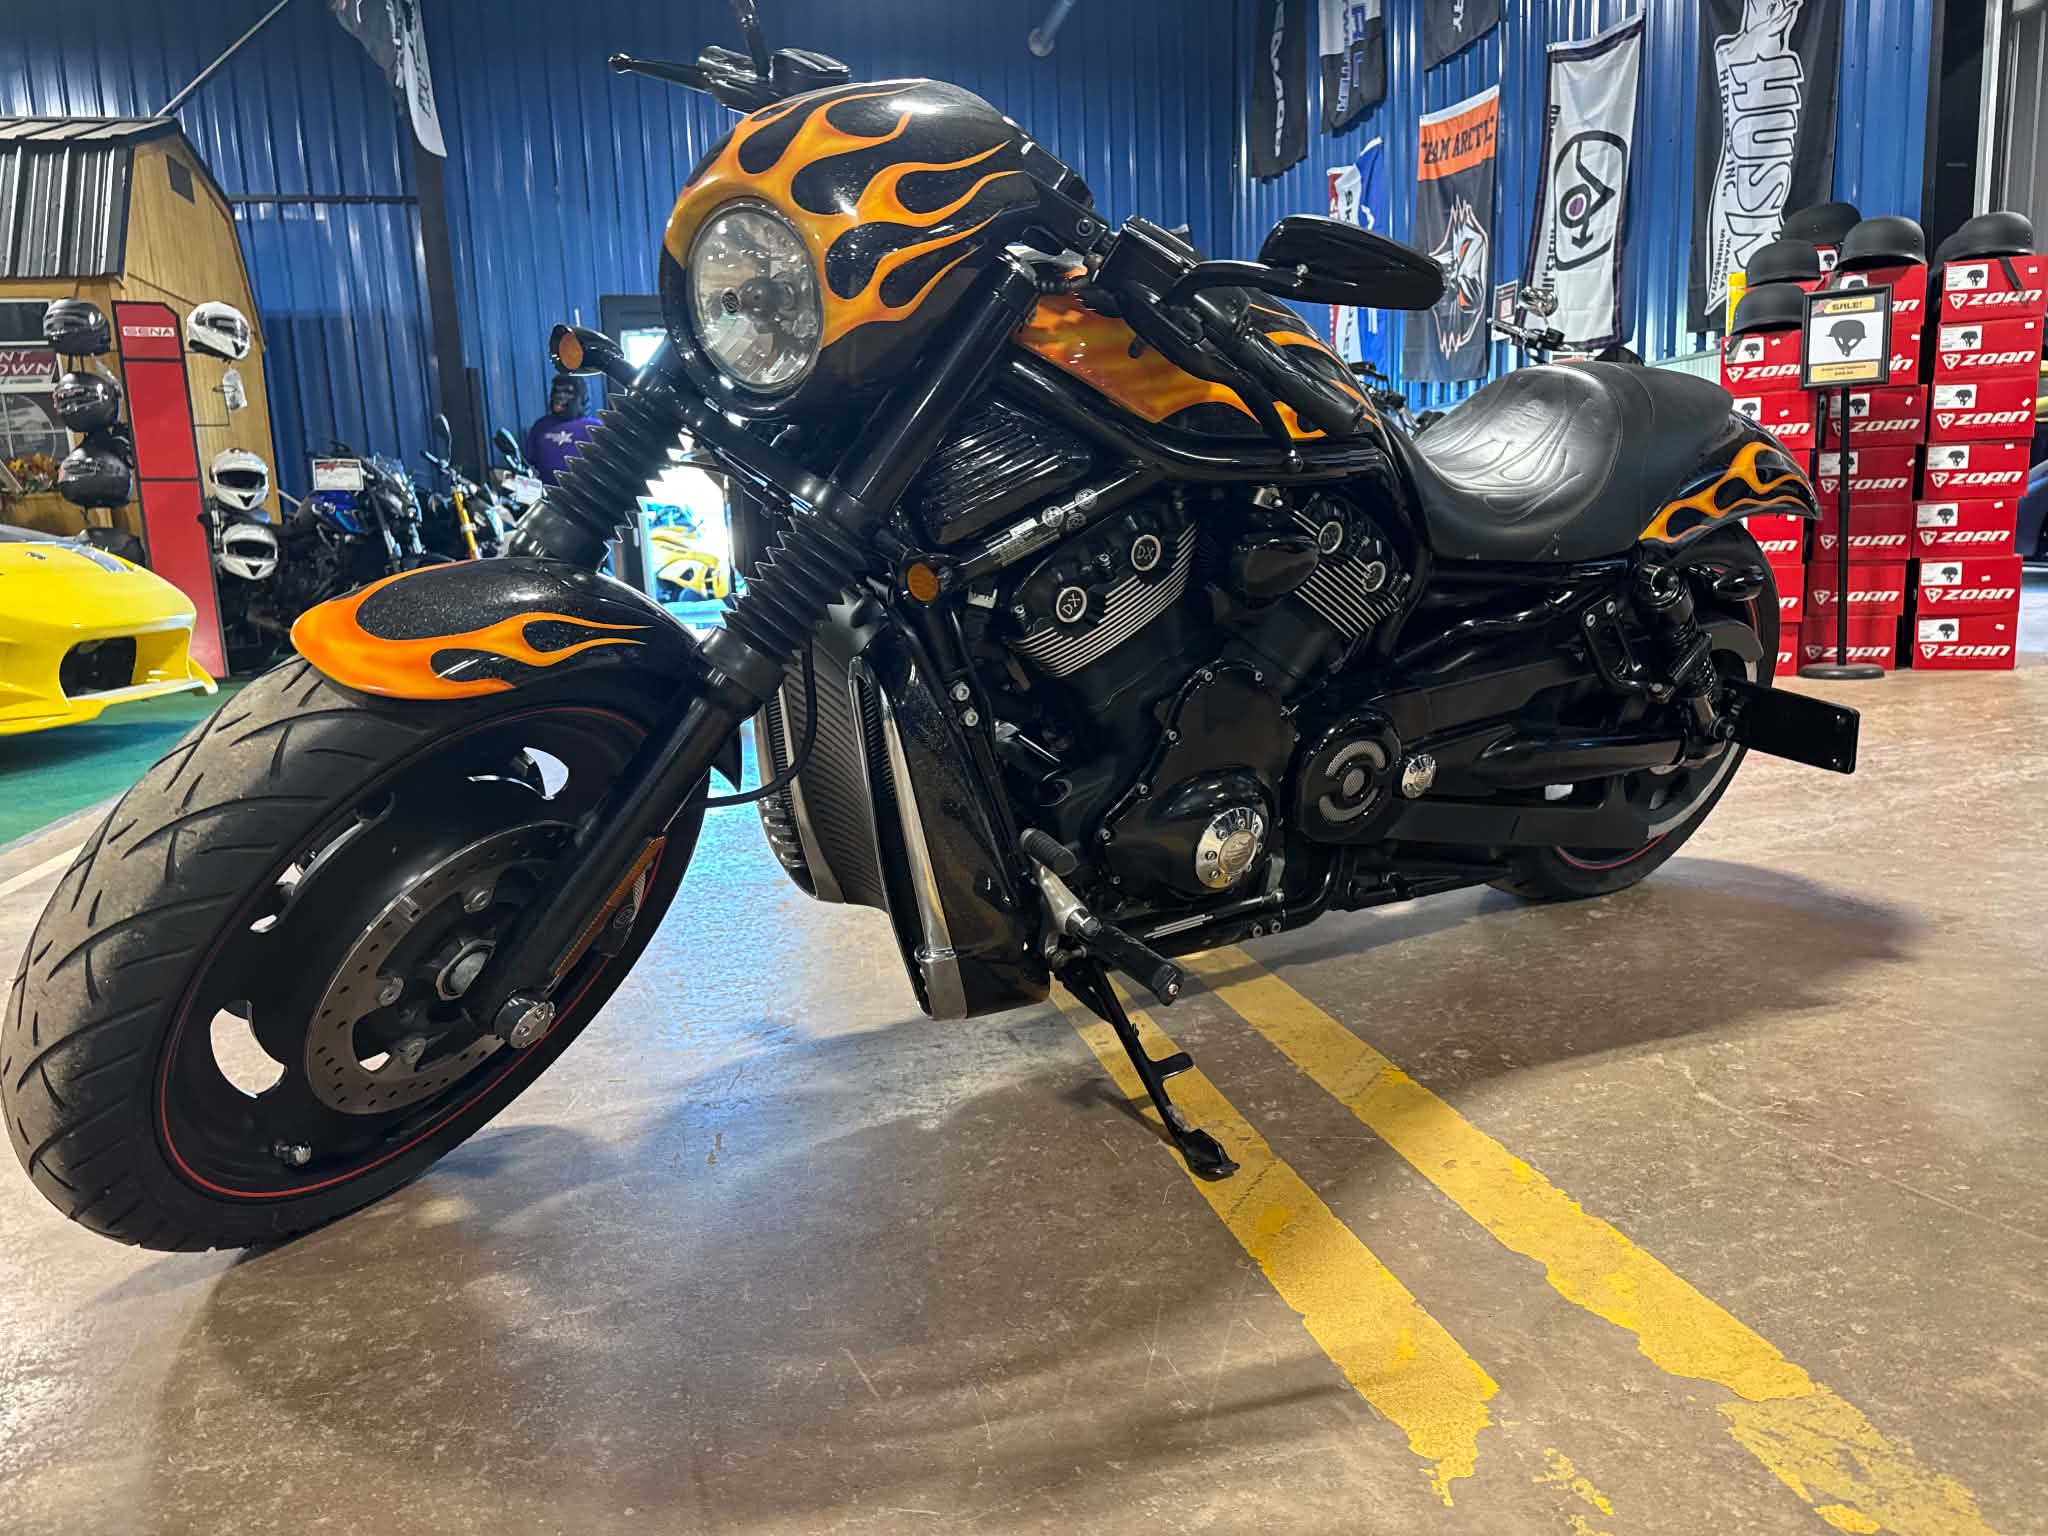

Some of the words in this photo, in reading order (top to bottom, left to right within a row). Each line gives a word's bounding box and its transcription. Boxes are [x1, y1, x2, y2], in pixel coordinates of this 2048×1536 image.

[1452, 115, 1494, 158] ARCTC
[1725, 54, 1801, 269] HUSK
[1721, 160, 1737, 198] INC.
[1967, 289, 2043, 306] ZOAN
[1960, 350, 2036, 367] ZOAN
[1743, 364, 1800, 379] ZOA
[1849, 418, 1920, 432] ZOAN
[1954, 410, 2031, 426] ZOAN
[1847, 477, 1908, 491] OAN
[1948, 471, 2024, 485] ZOAN
[1847, 535, 1906, 546] OAN
[1936, 530, 2010, 543] ZOAN
[1136, 545, 1155, 560] DX
[1941, 588, 2016, 600] ZOAN
[1062, 593, 1080, 615] DX
[1937, 645, 2011, 656] ZOAN
